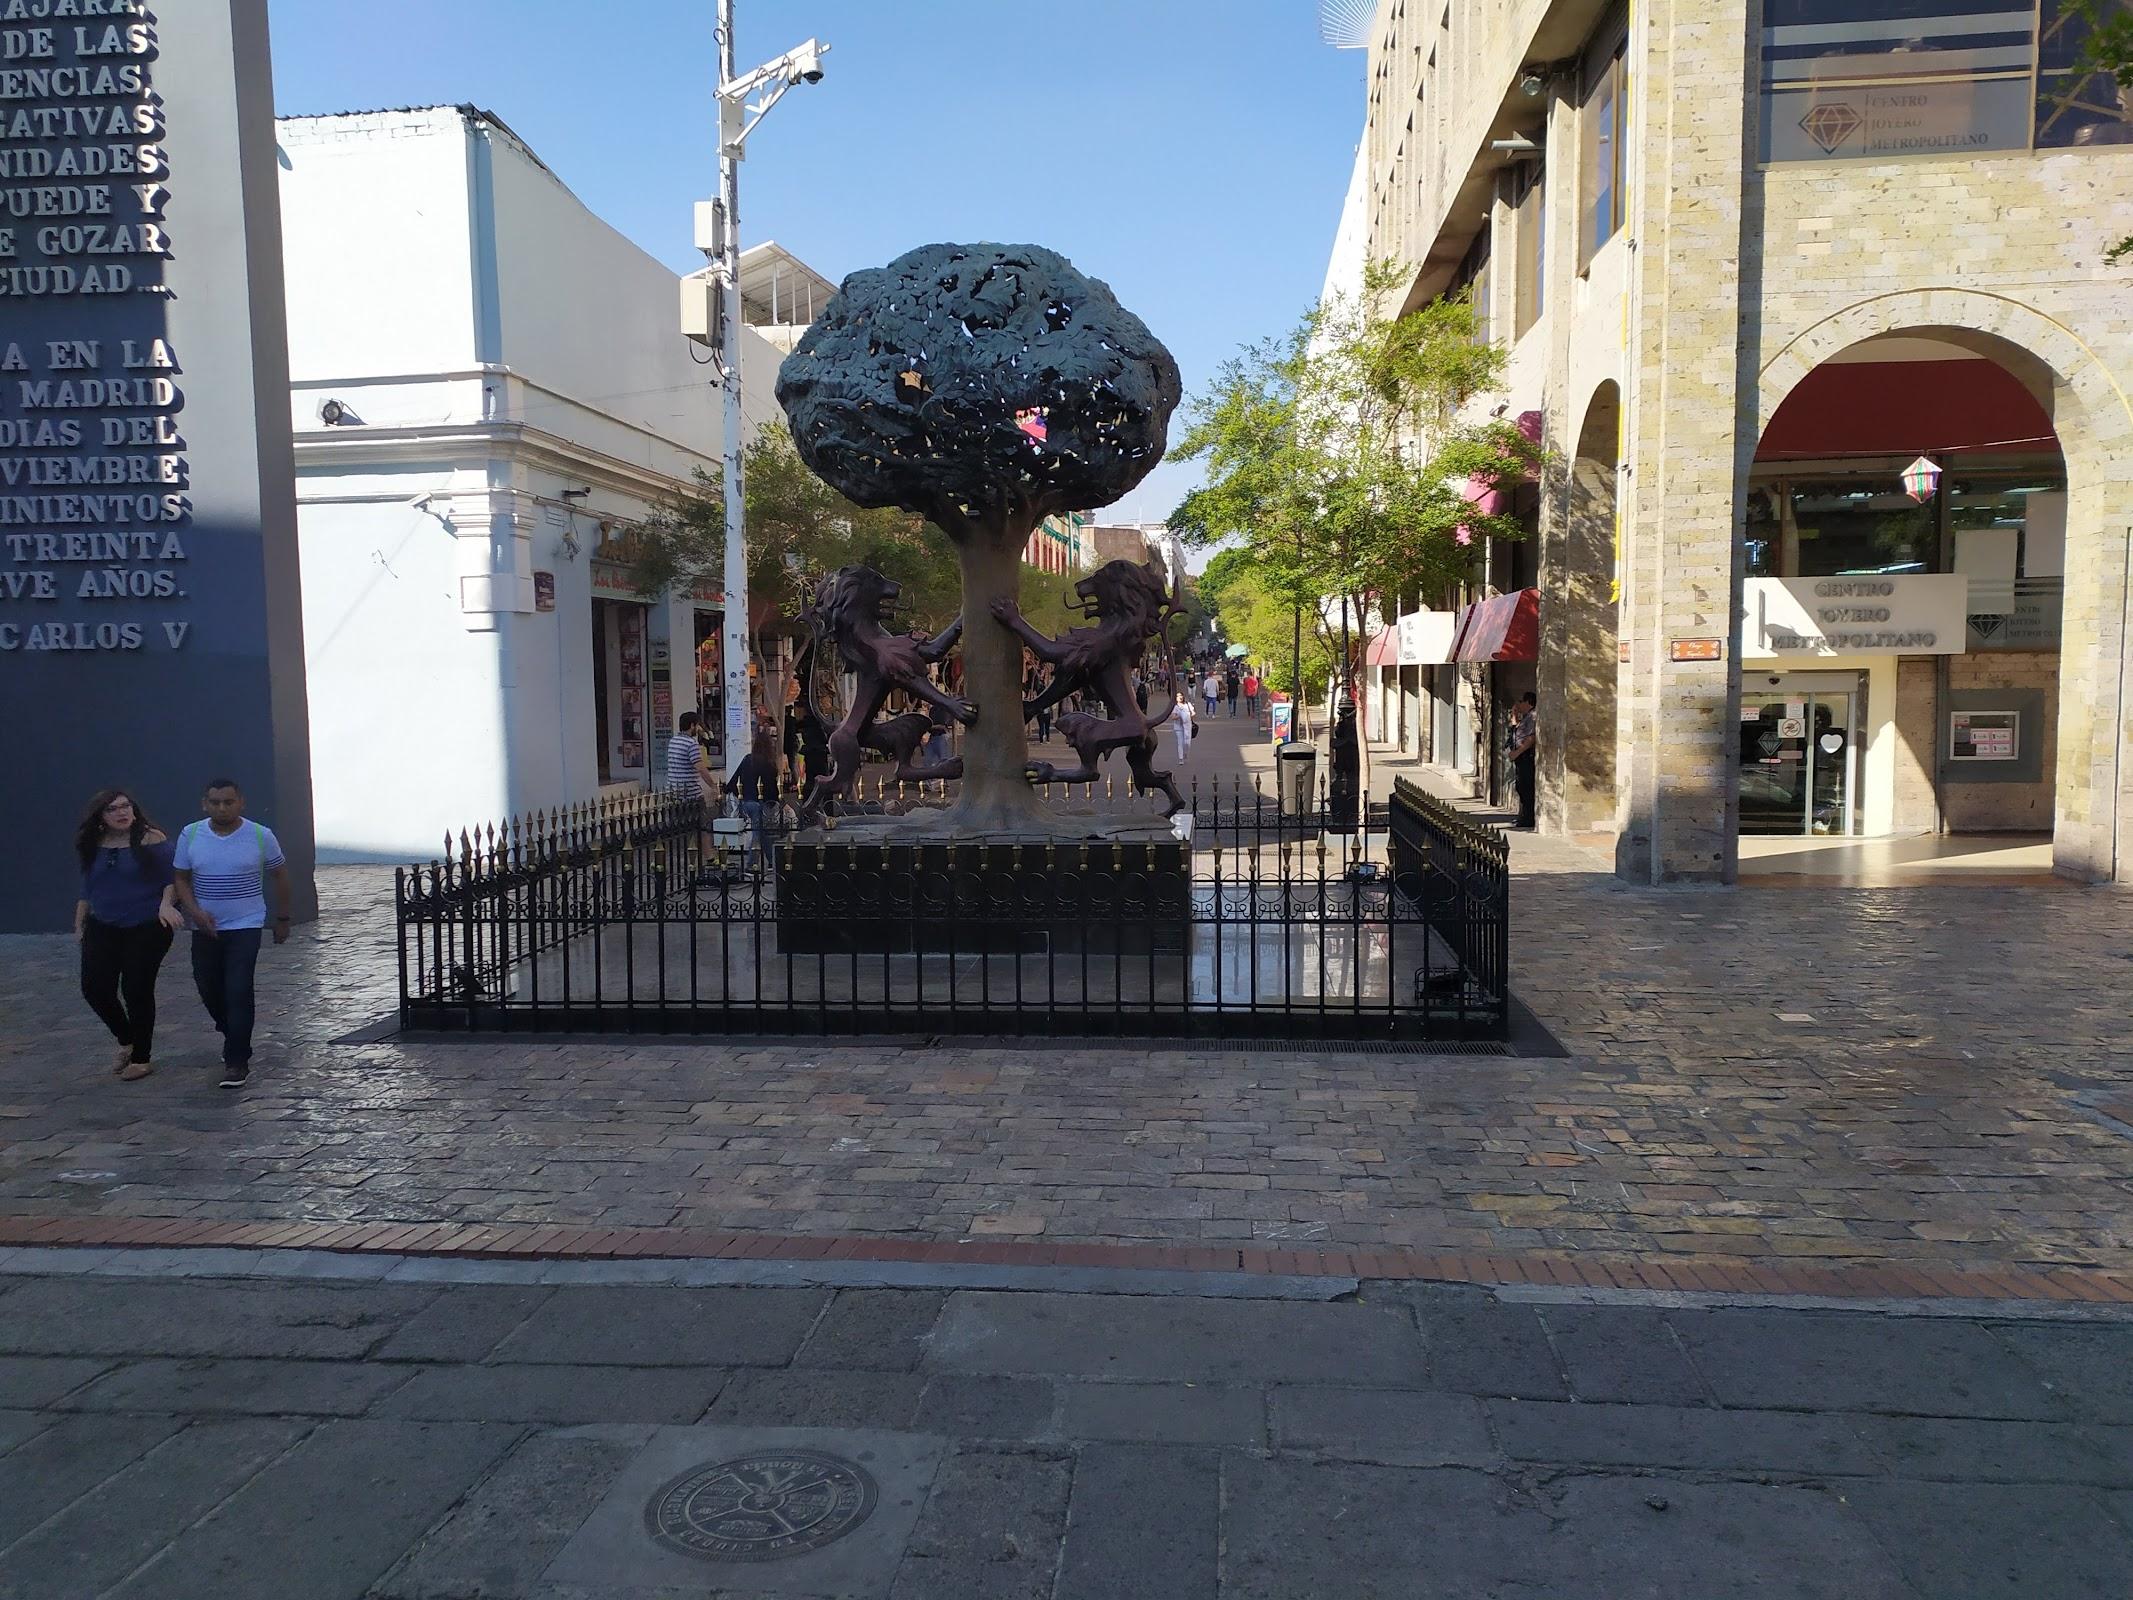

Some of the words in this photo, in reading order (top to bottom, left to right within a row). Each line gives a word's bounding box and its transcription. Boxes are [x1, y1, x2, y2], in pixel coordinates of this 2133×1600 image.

[0, 0, 145, 20] AJARA,
[3, 28, 53, 58] DE
[74, 24, 148, 55] LAS
[1872, 95, 1928, 108] CENTRO
[0, 105, 155, 139] ATIVAS
[1872, 118, 1922, 131] JOYERO
[1871, 133, 1989, 150] METROPOLITANO
[0, 185, 110, 217] UEDE
[131, 184, 160, 213] Y
[37, 223, 164, 255] GOZAR
[2, 343, 29, 370] A
[47, 341, 99, 369] EN
[121, 339, 172, 367] LA
[20, 378, 174, 408] MADRID
[0, 419, 81, 447] DIAS
[101, 416, 176, 446] DEL
[0, 455, 178, 485] VIEMBRE
[0, 494, 181, 523] INIENTOS
[6, 532, 185, 561] TREINTA
[0, 570, 56, 598] VE
[77, 565, 185, 598] AÑOS.
[1814, 582, 1894, 598] CENTRO
[1818, 608, 1891, 624] JOYERO
[0, 623, 141, 650] CARLOS
[162, 622, 188, 648] V
[1772, 633, 1938, 649] METROPOLITANO
